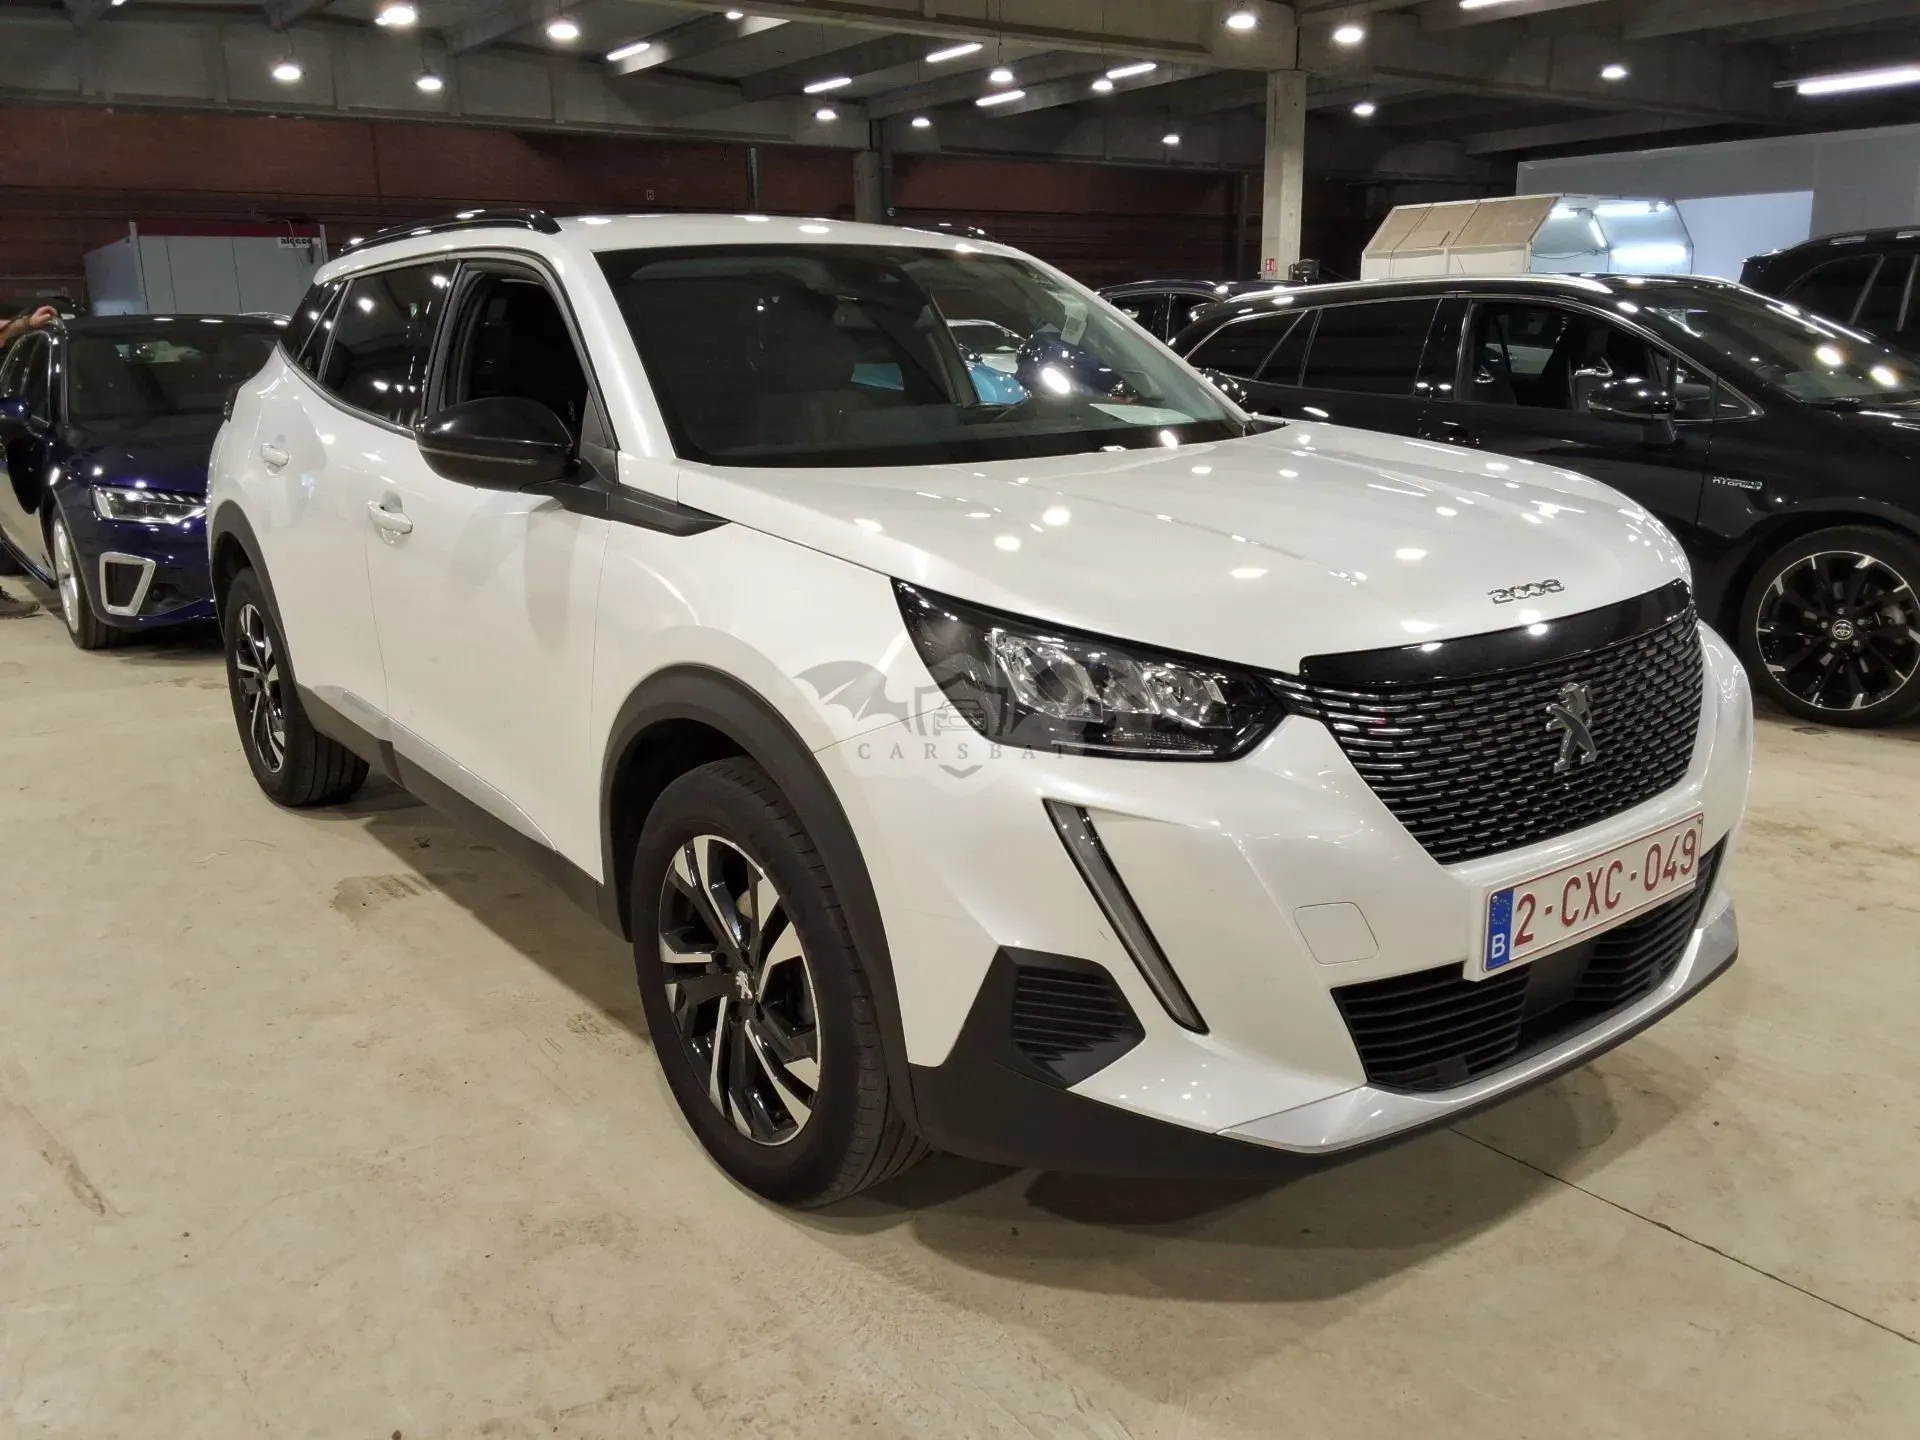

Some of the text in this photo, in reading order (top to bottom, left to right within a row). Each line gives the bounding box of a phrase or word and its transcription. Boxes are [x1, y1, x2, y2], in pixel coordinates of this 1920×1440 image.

[1487, 579, 1565, 604] 2008
[1514, 828, 1697, 947] 2-CXC-049
[1491, 933, 1505, 959] B
